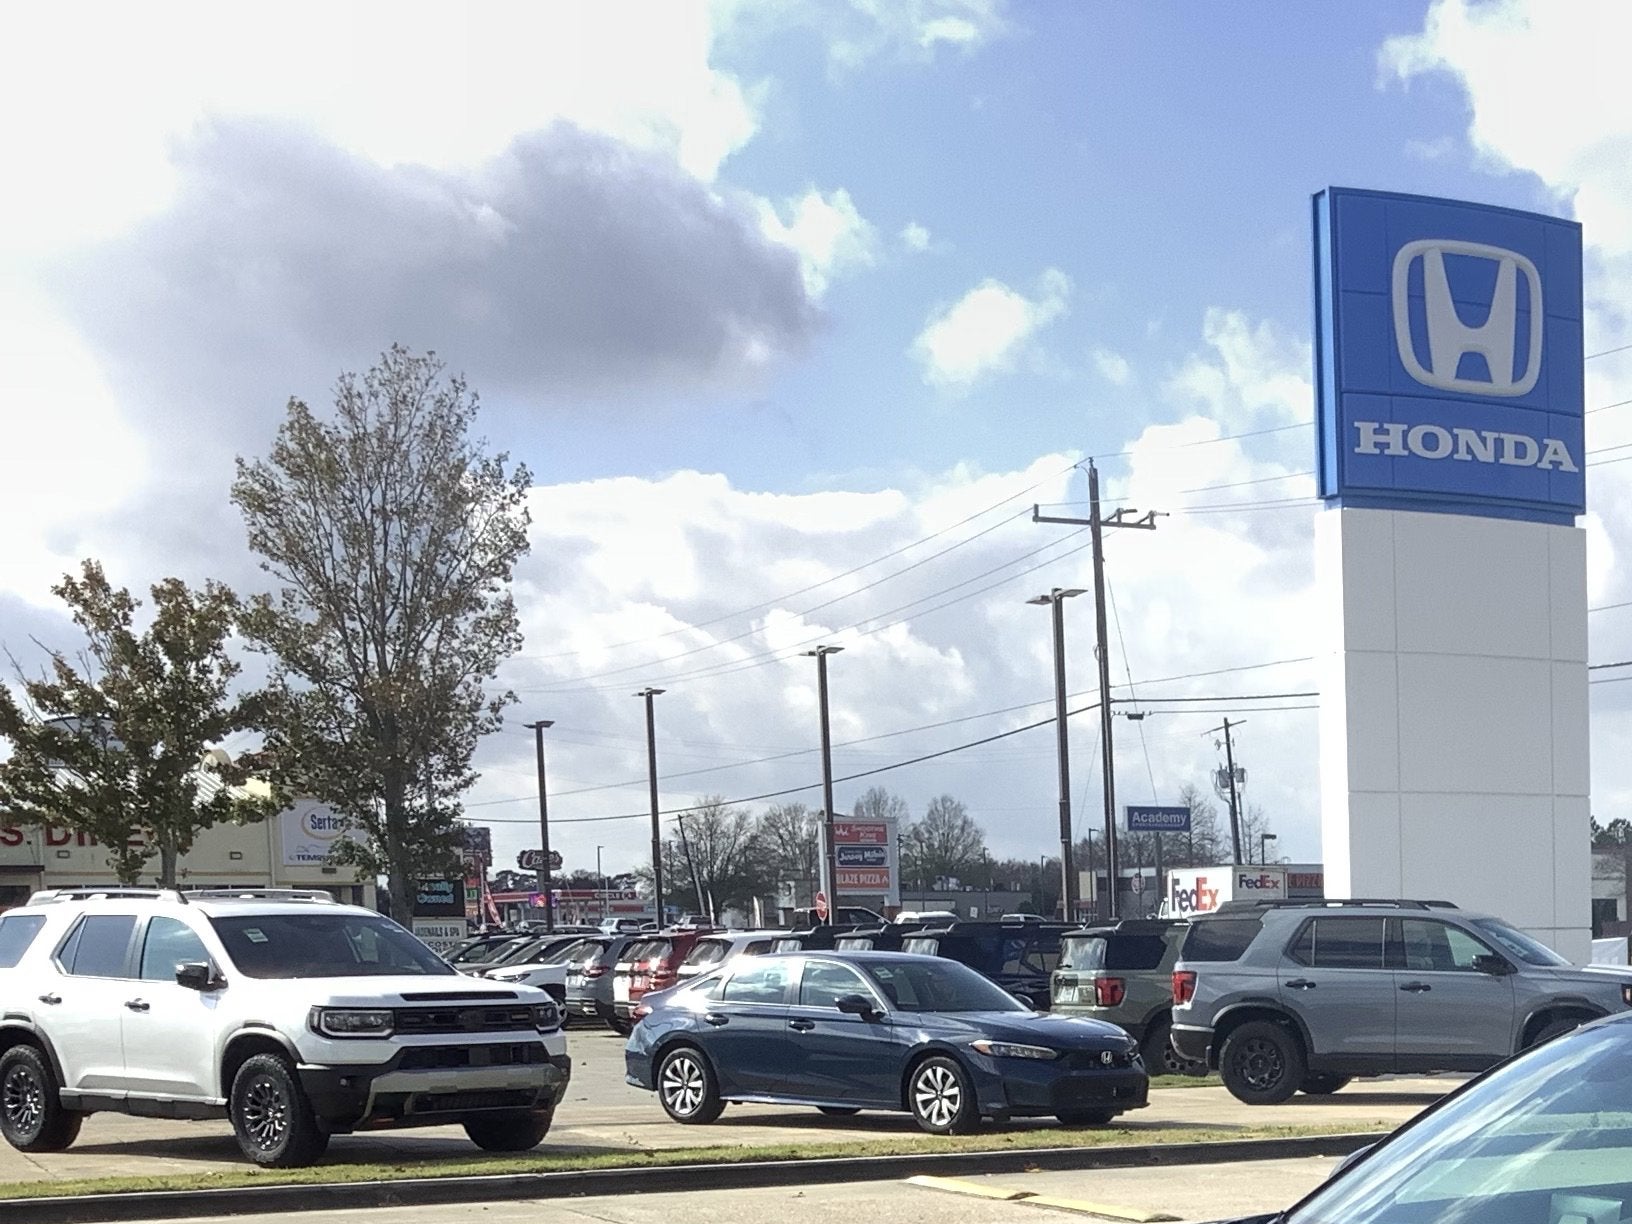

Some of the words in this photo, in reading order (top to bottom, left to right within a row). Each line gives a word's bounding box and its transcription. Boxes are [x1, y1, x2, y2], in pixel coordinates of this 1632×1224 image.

[1354, 421, 1579, 473] HONDA
[310, 814, 339, 830] Serta
[1132, 812, 1187, 825] Academy
[860, 873, 881, 884] PIZZA
[1238, 874, 1280, 890] FedEx
[1171, 876, 1219, 912] FedEx
